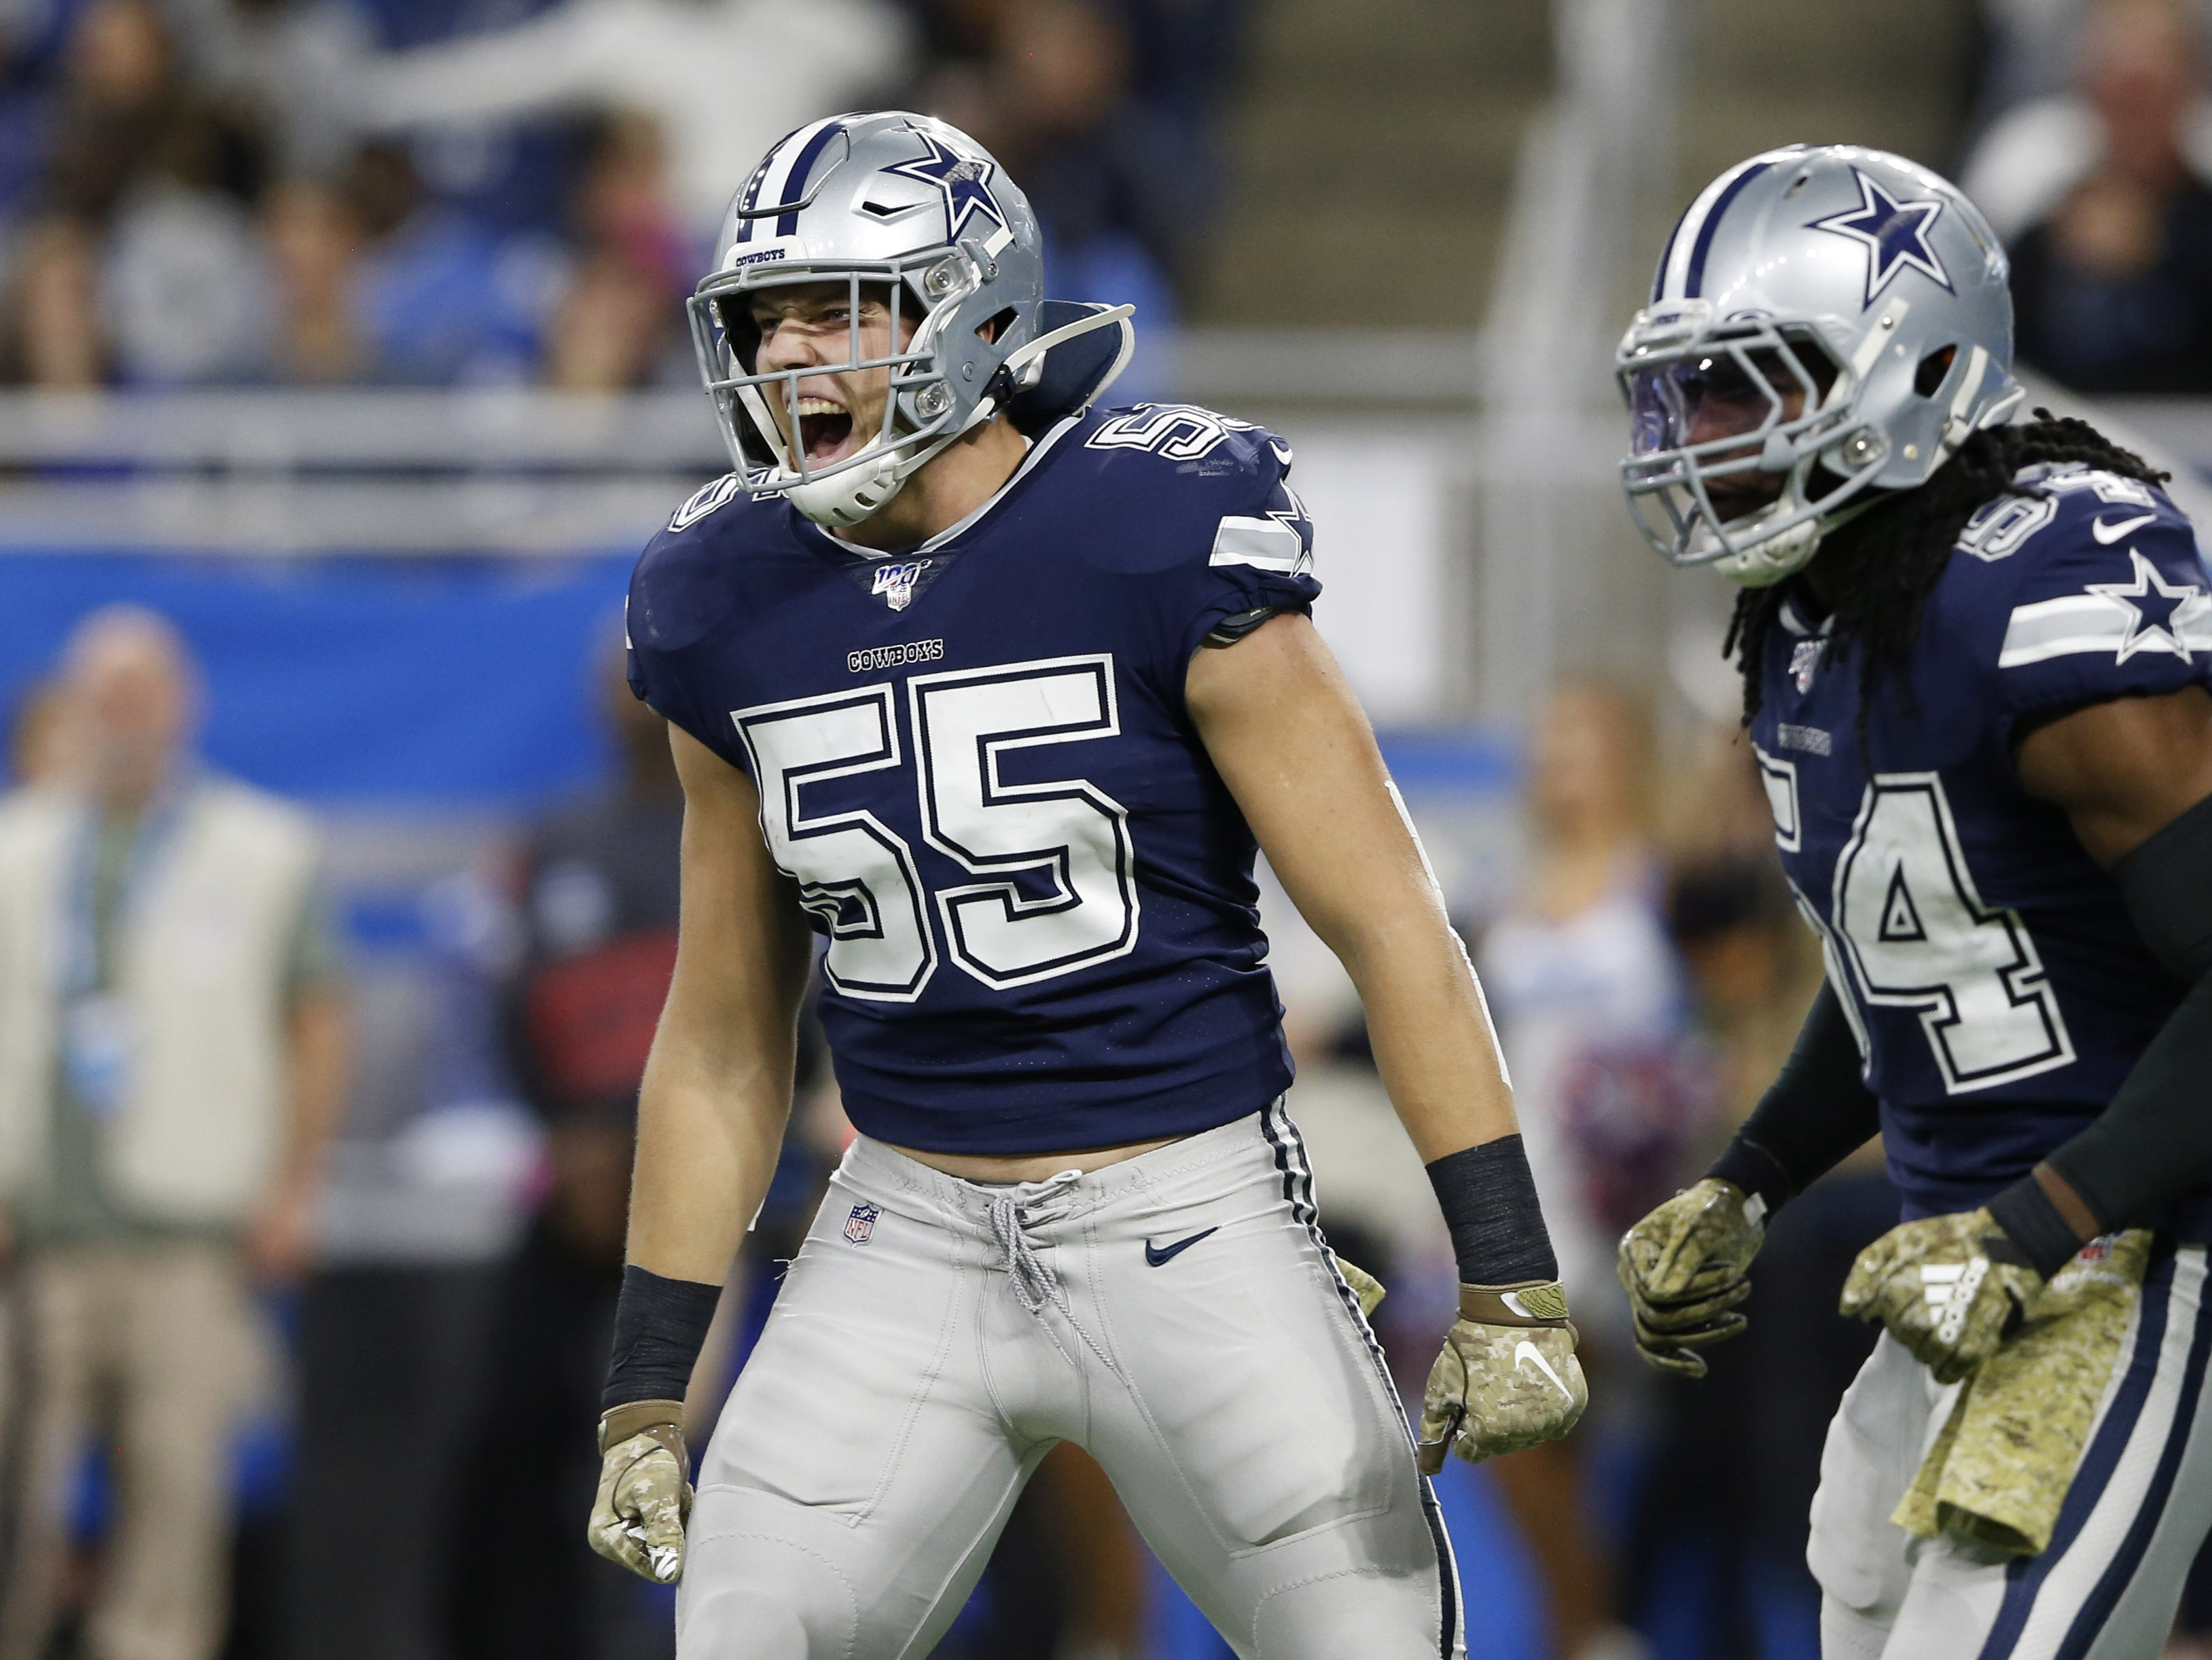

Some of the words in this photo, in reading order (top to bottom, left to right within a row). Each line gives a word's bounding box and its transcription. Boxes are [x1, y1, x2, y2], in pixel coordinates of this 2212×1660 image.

[736, 249, 785, 267] COWBOYS
[847, 638, 944, 672] COWBOYS
[730, 653, 1141, 1003] 55
[846, 1219, 869, 1240] NFL
